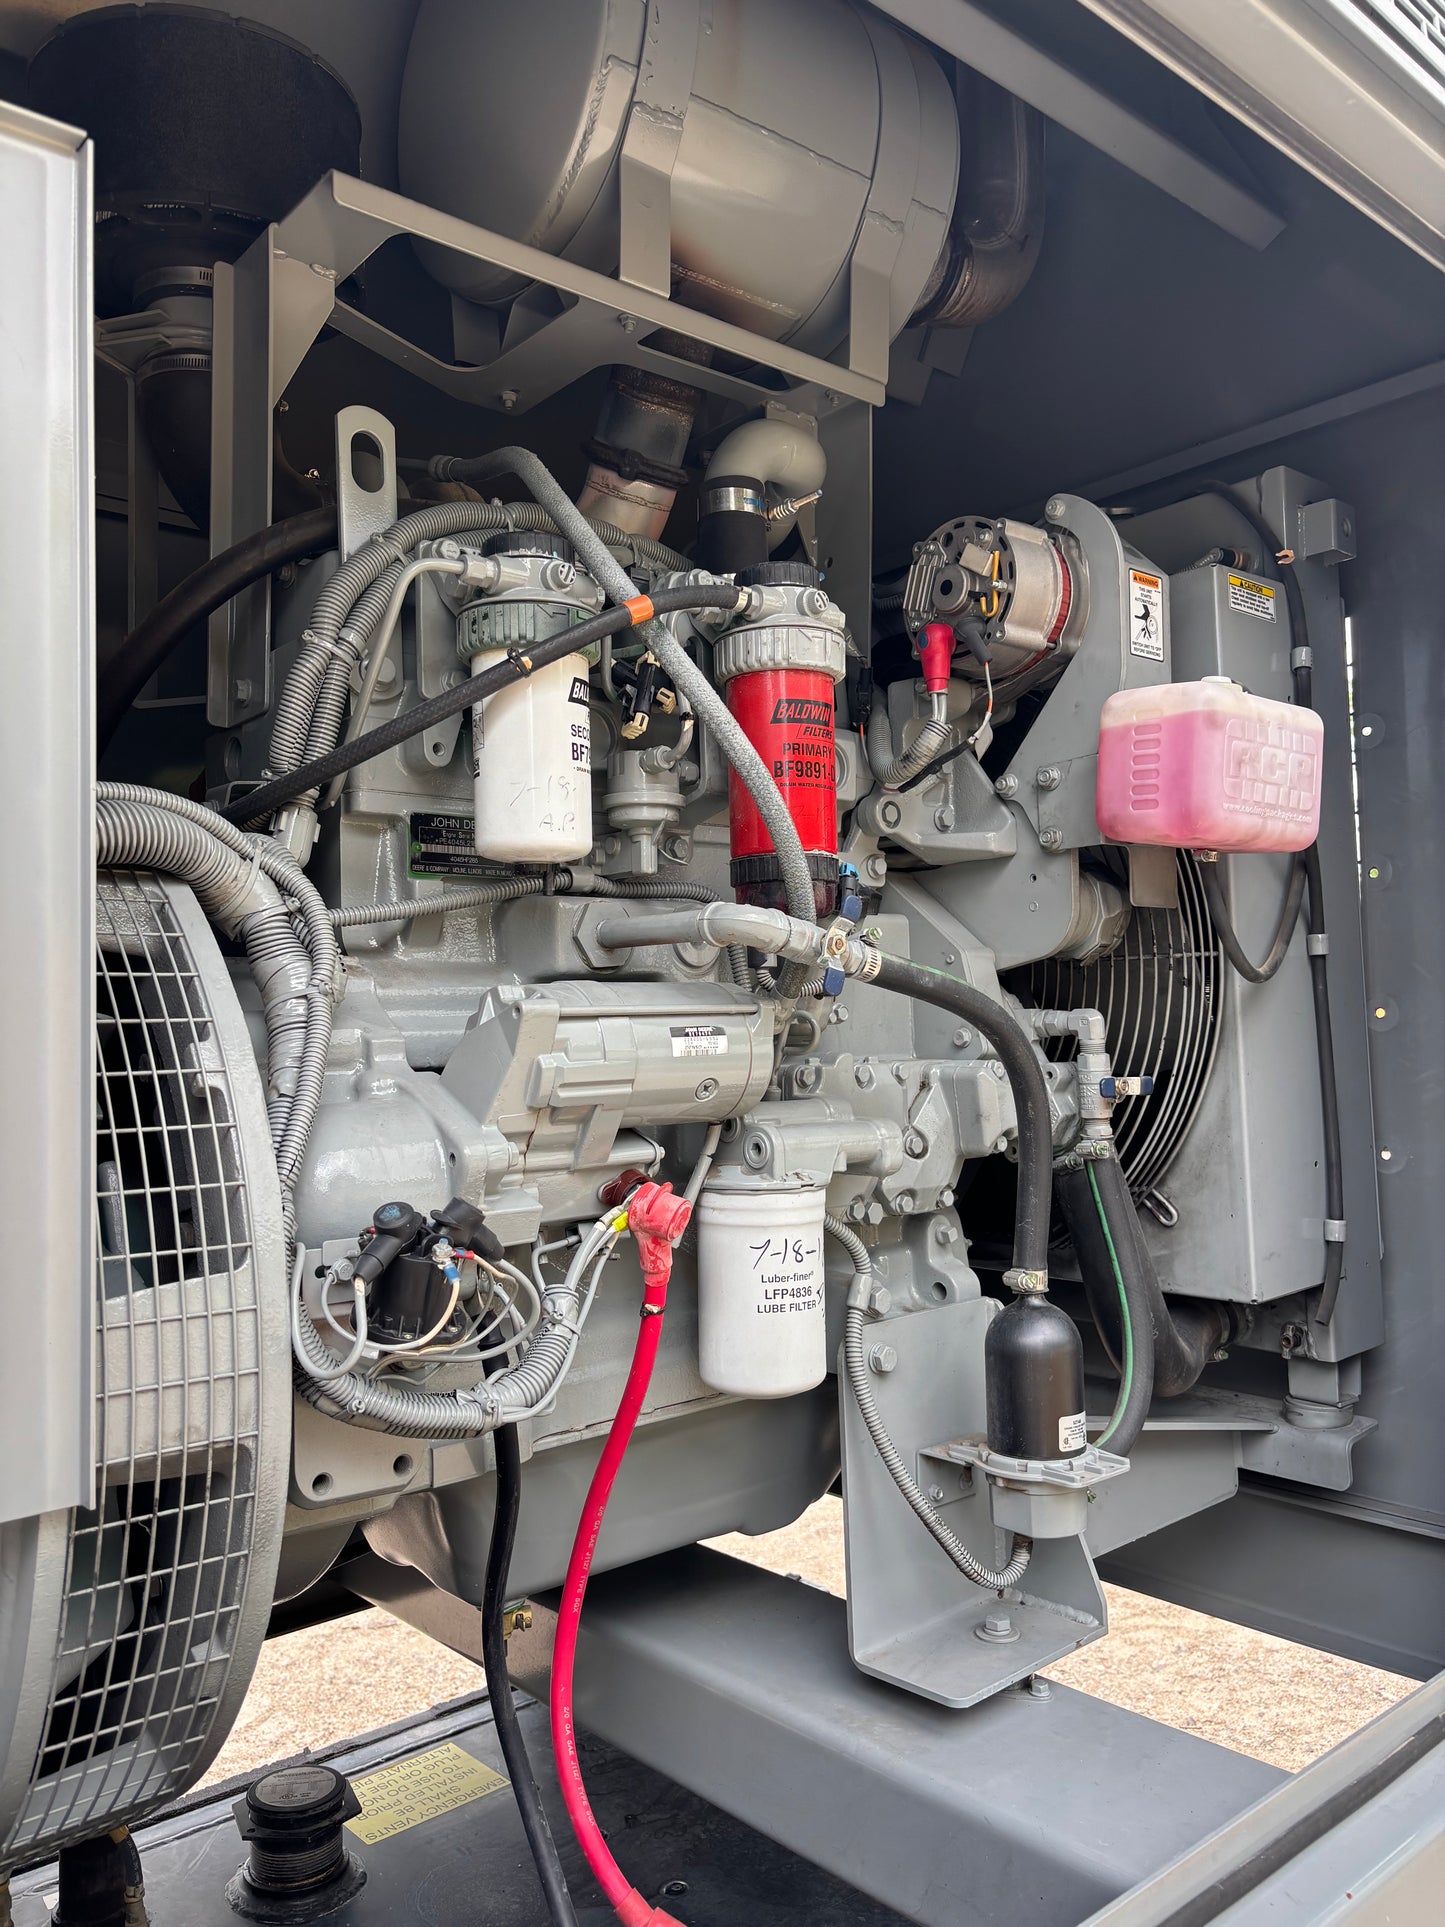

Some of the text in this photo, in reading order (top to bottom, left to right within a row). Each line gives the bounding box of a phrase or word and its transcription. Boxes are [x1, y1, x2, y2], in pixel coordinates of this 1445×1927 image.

[1138, 576, 1158, 588] WARNING
[1243, 581, 1264, 594] CAUTION
[776, 702, 831, 722] BALDWIN
[803, 727, 832, 740] FILTERS
[782, 743, 832, 759] PRIMARY
[1222, 802, 1312, 824] www.coolingpackages.com
[430, 817, 460, 829] JOHN
[764, 1286, 812, 1300] LFP4836
[757, 1300, 816, 1314] LUBE FILTER
[577, 1575, 586, 1594] TYPE
[376, 1746, 451, 1780] ALTERNATE
[423, 1753, 462, 1771] PLUG
[400, 1769, 422, 1780] OR
[361, 1764, 463, 1807] TO USE DO NO
[371, 1780, 399, 1794] USE
[356, 1768, 478, 1821] INSTALLED PRIOR
[393, 1785, 461, 1817] SHALL BE
[365, 1776, 506, 1841] EMERGENCY VENTS
